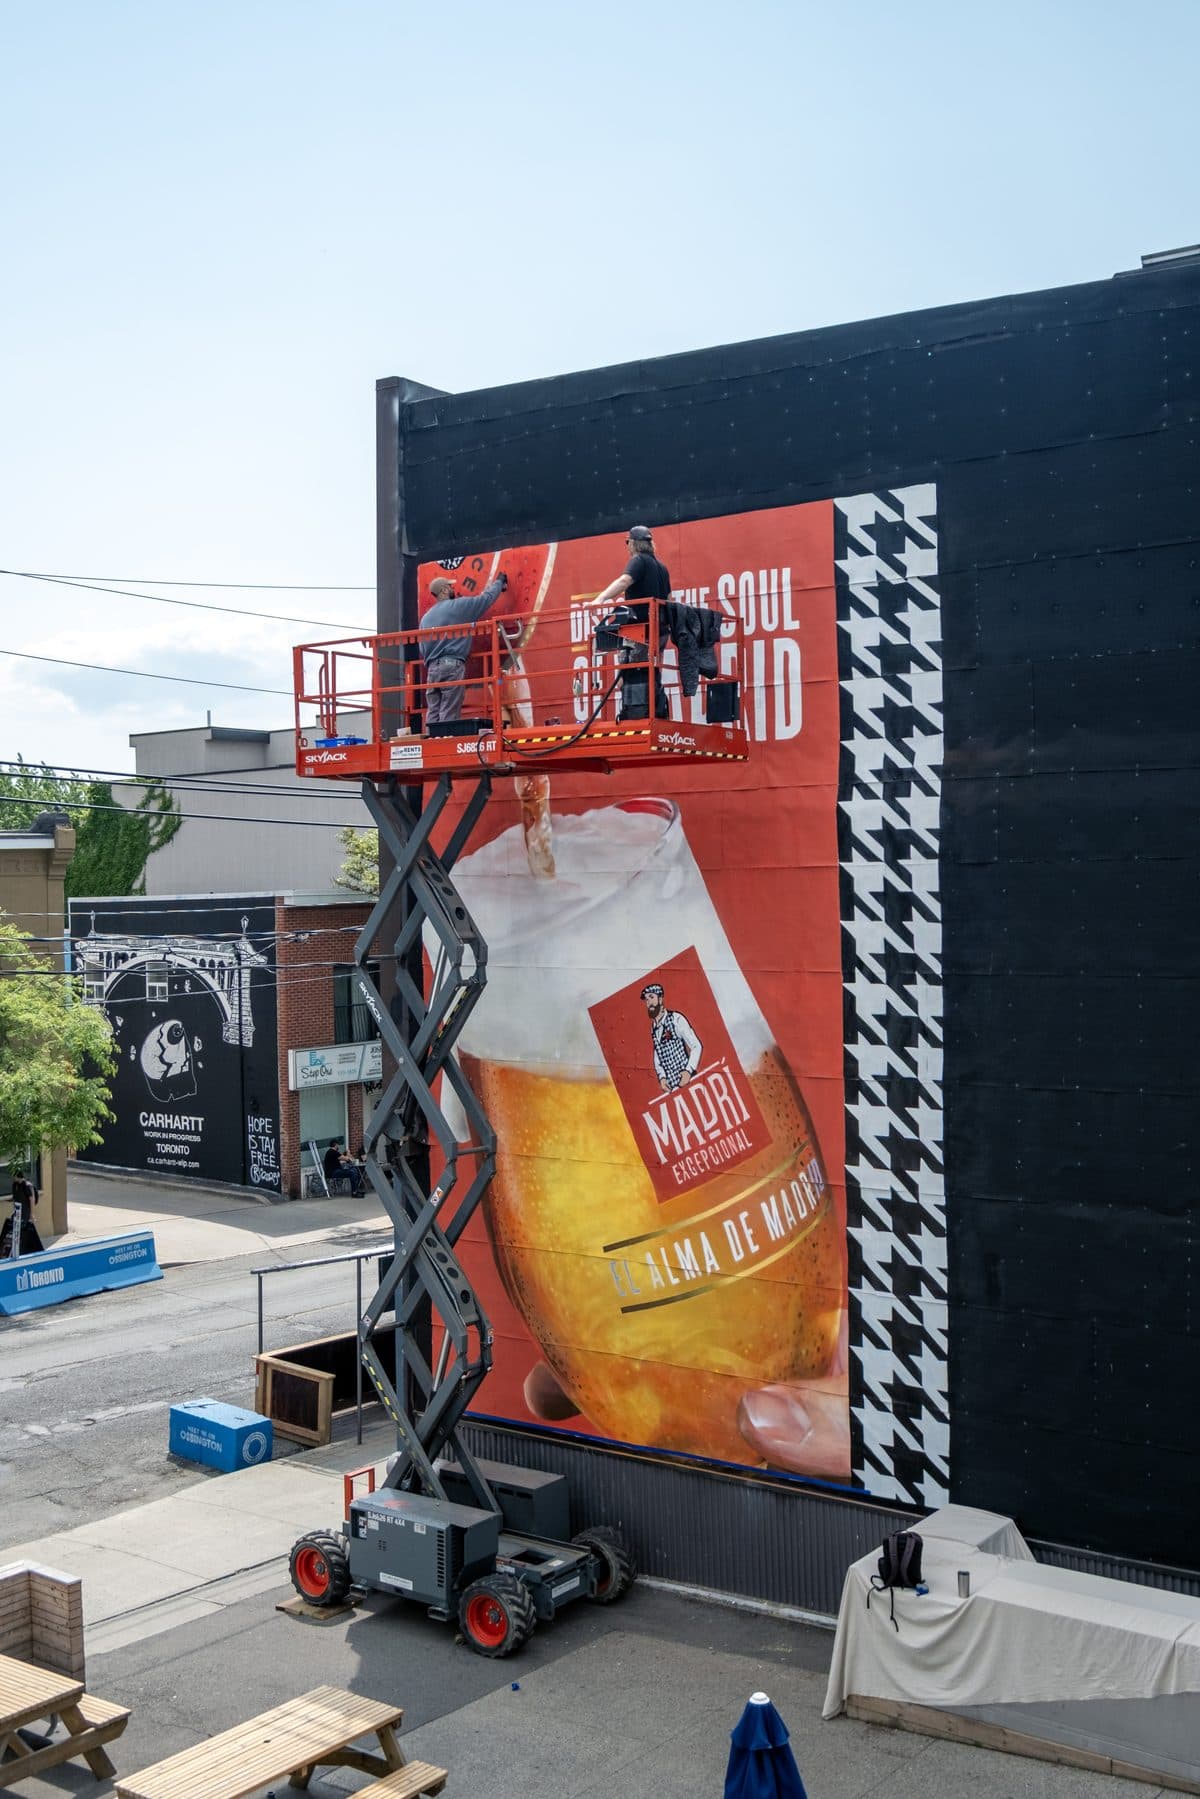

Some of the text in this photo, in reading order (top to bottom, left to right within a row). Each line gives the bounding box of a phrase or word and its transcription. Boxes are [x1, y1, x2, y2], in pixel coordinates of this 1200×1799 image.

[717, 567, 800, 638] SOUL
[486, 740, 497, 751] RT
[658, 731, 696, 746] SKYJACK
[305, 750, 347, 764] SKYJACK
[359, 981, 382, 1023] SKYJACK
[139, 1111, 205, 1132] CARHARTT
[247, 1114, 273, 1134] HOPE
[143, 1130, 161, 1139] WORK
[168, 1133, 202, 1142] PROGRESS
[248, 1134, 276, 1155] IS TAX
[156, 1143, 190, 1155] TORONTO
[671, 1128, 753, 1185] EXCEPCIONAL
[108, 1248, 147, 1264] OSSINGTON
[608, 1258, 641, 1297] EL
[645, 1231, 721, 1289] ALMA
[723, 1211, 760, 1262] DE
[28, 1266, 65, 1289] TORONTO
